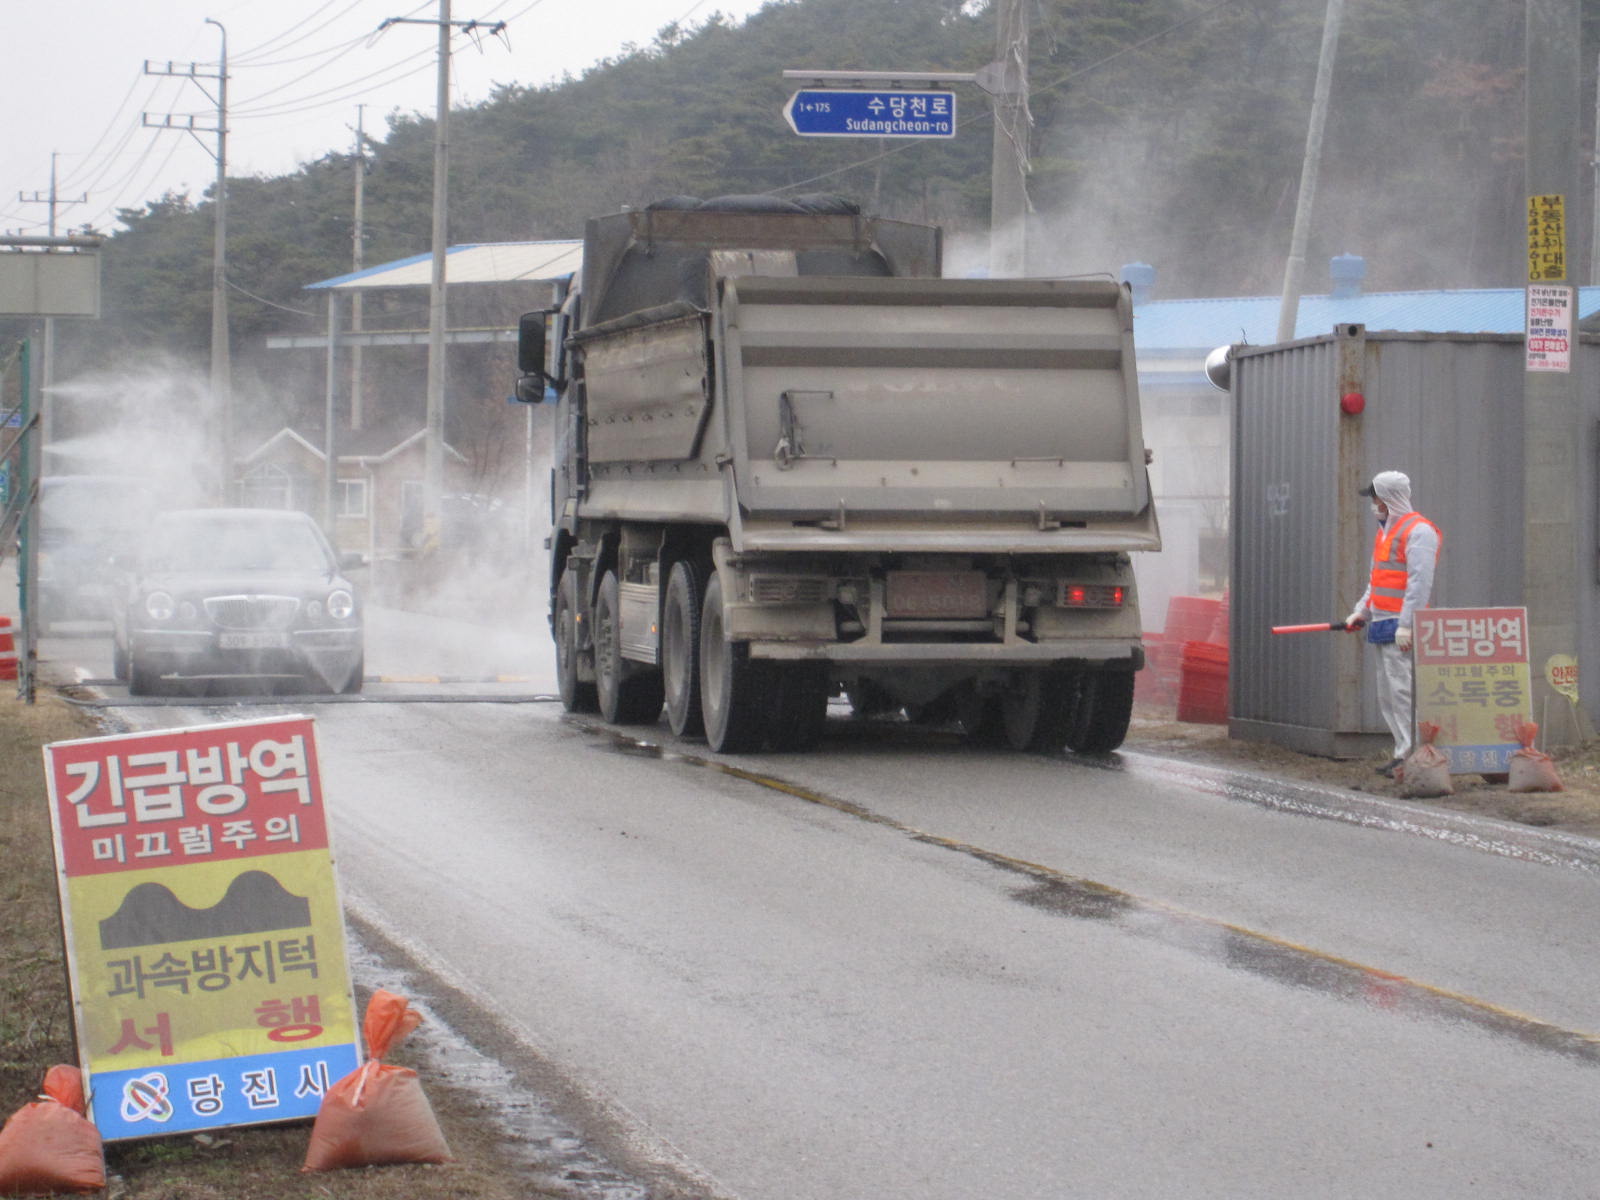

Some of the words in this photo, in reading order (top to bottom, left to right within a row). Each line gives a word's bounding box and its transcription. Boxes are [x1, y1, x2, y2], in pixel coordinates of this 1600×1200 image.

[846, 118, 948, 133] Sudangcheon-ro
[867, 96, 948, 118] 수당천로
[1420, 617, 1523, 657] 긴급방역
[1428, 680, 1523, 707] 소독중
[65, 734, 312, 829] 긴급방역
[91, 813, 300, 864] 미끄럼주의
[105, 935, 319, 1000] 과속방지턱
[186, 1061, 331, 1115] 당진시
